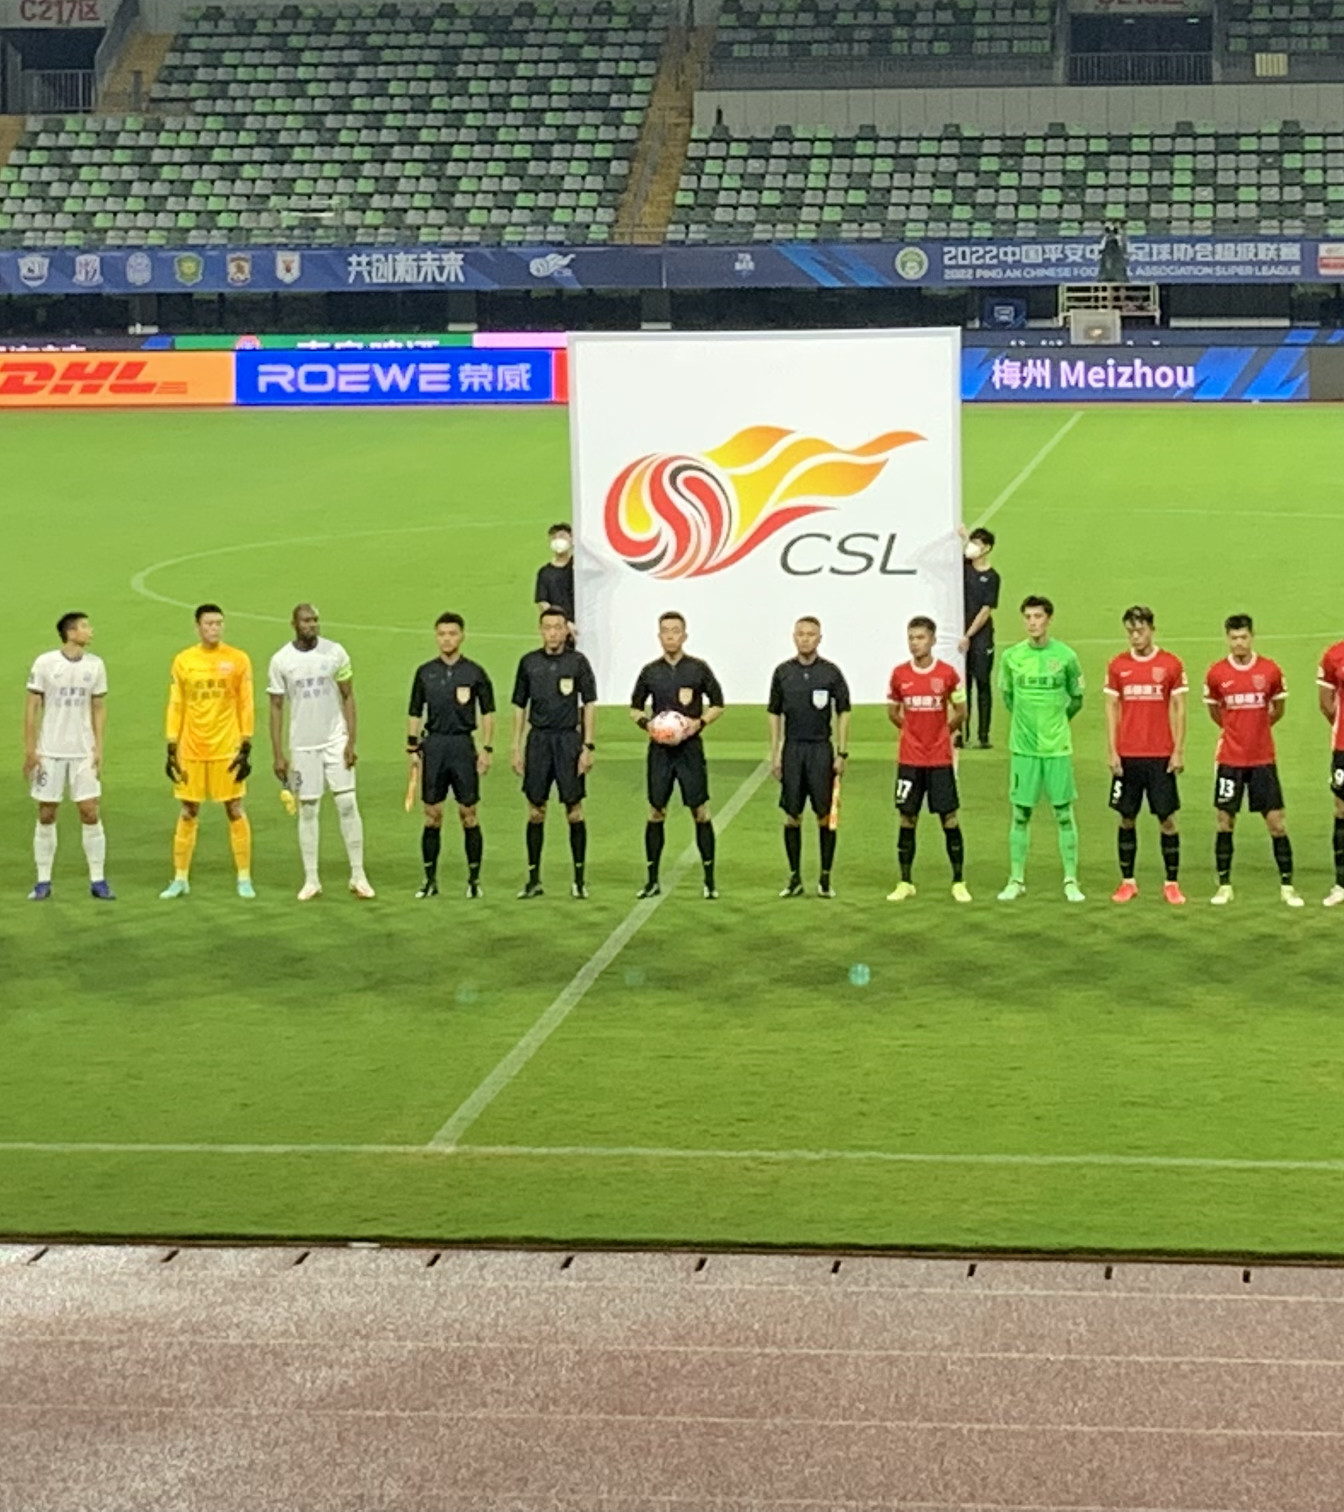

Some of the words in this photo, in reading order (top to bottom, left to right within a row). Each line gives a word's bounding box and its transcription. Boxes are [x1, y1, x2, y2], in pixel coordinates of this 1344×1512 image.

[347, 251, 465, 284] 共创新未来
[943, 242, 1301, 265] 2022中国平安中足球协会超级联赛
[258, 364, 452, 391] ROEWE
[458, 362, 532, 392] 荣威
[992, 359, 1052, 389] 梅州
[1060, 359, 1195, 389] Meizhou
[779, 533, 918, 576] CSL
[1218, 777, 1236, 798] 13
